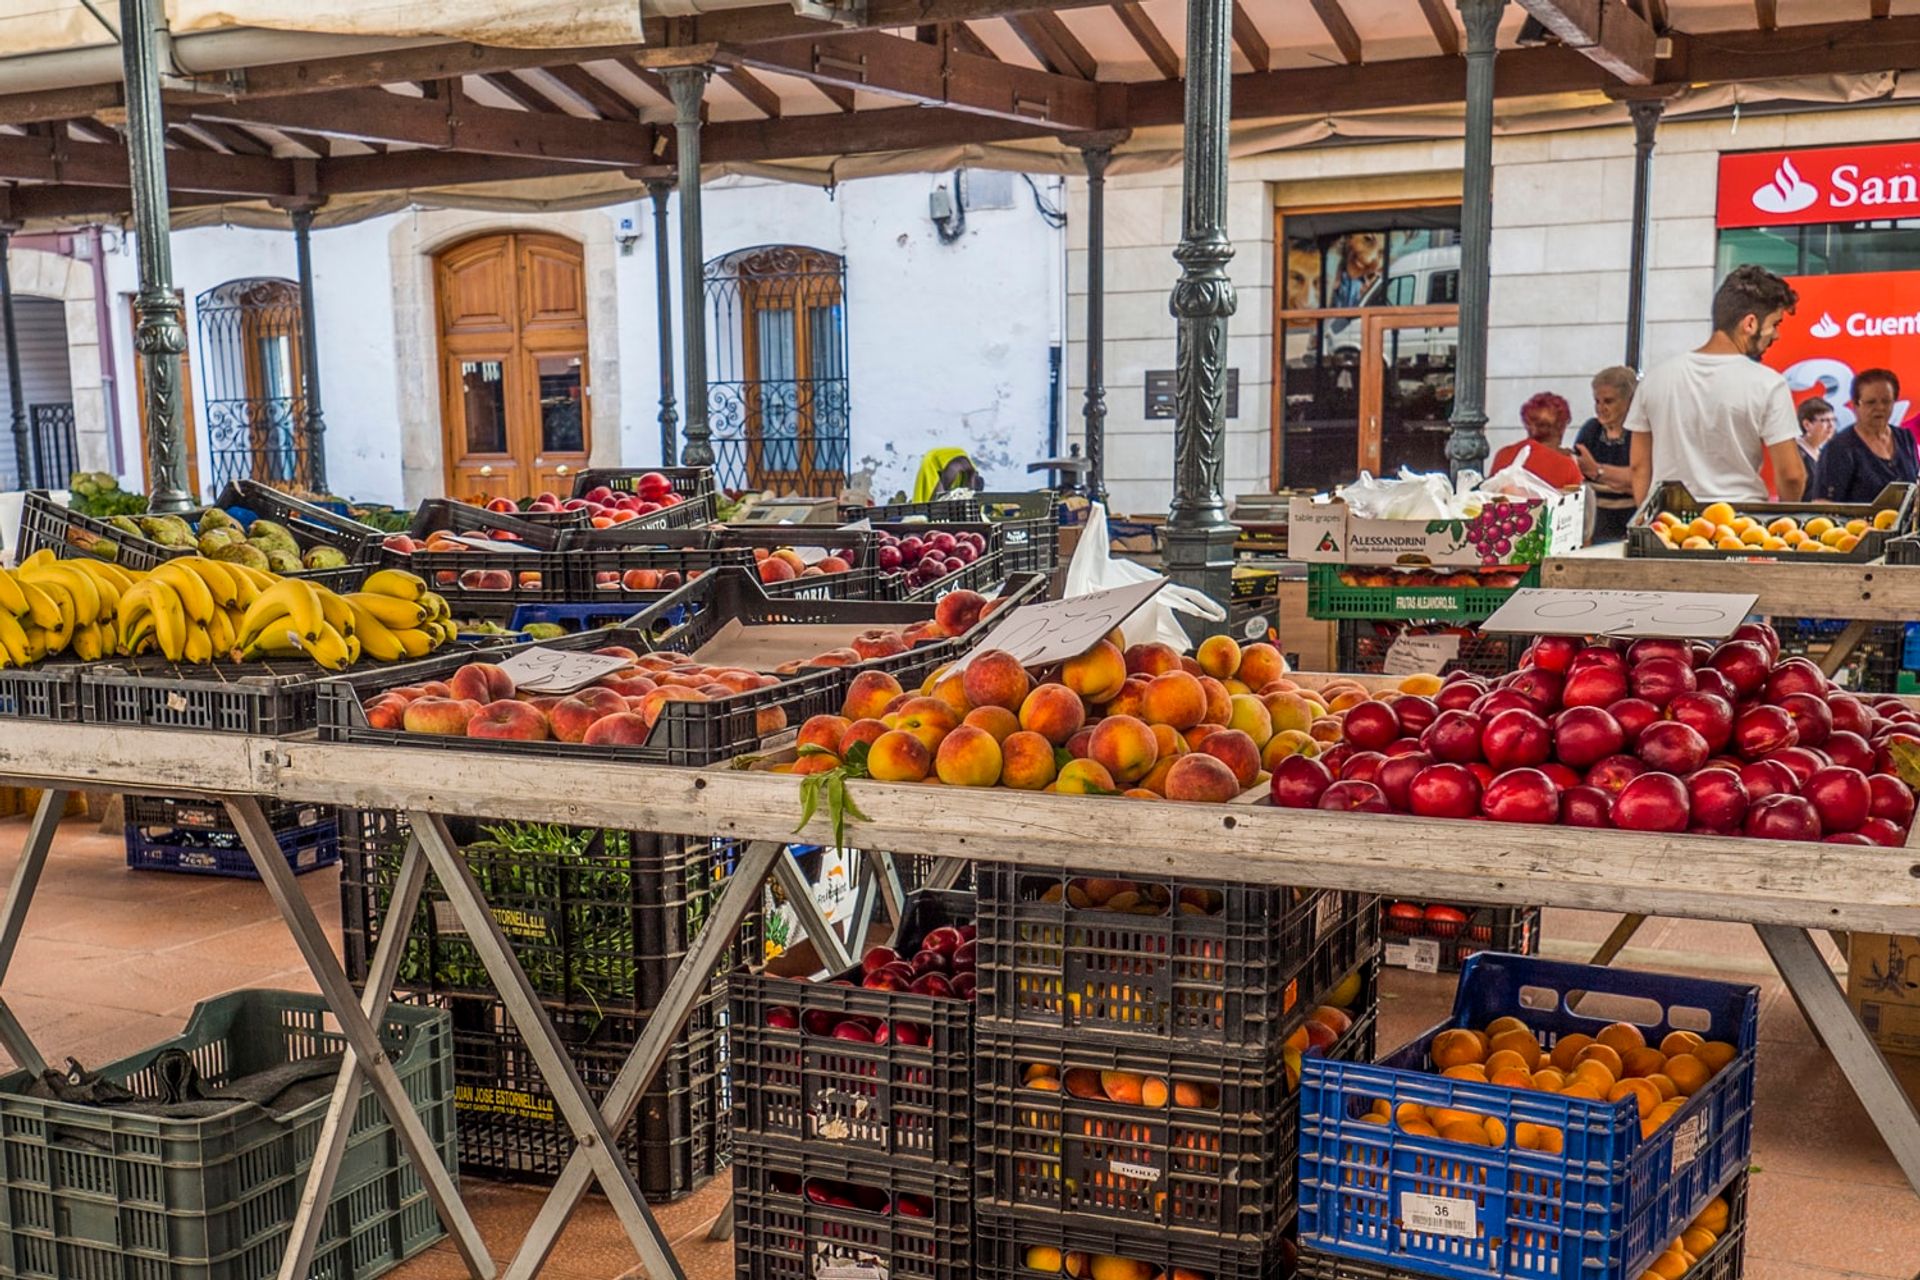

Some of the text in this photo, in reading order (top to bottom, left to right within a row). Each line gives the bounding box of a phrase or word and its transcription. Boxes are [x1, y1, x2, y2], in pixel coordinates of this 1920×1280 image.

[1829, 164, 1920, 208] San
[474, 1087, 495, 1104] JOSE
[1434, 1205, 1449, 1217] 36
